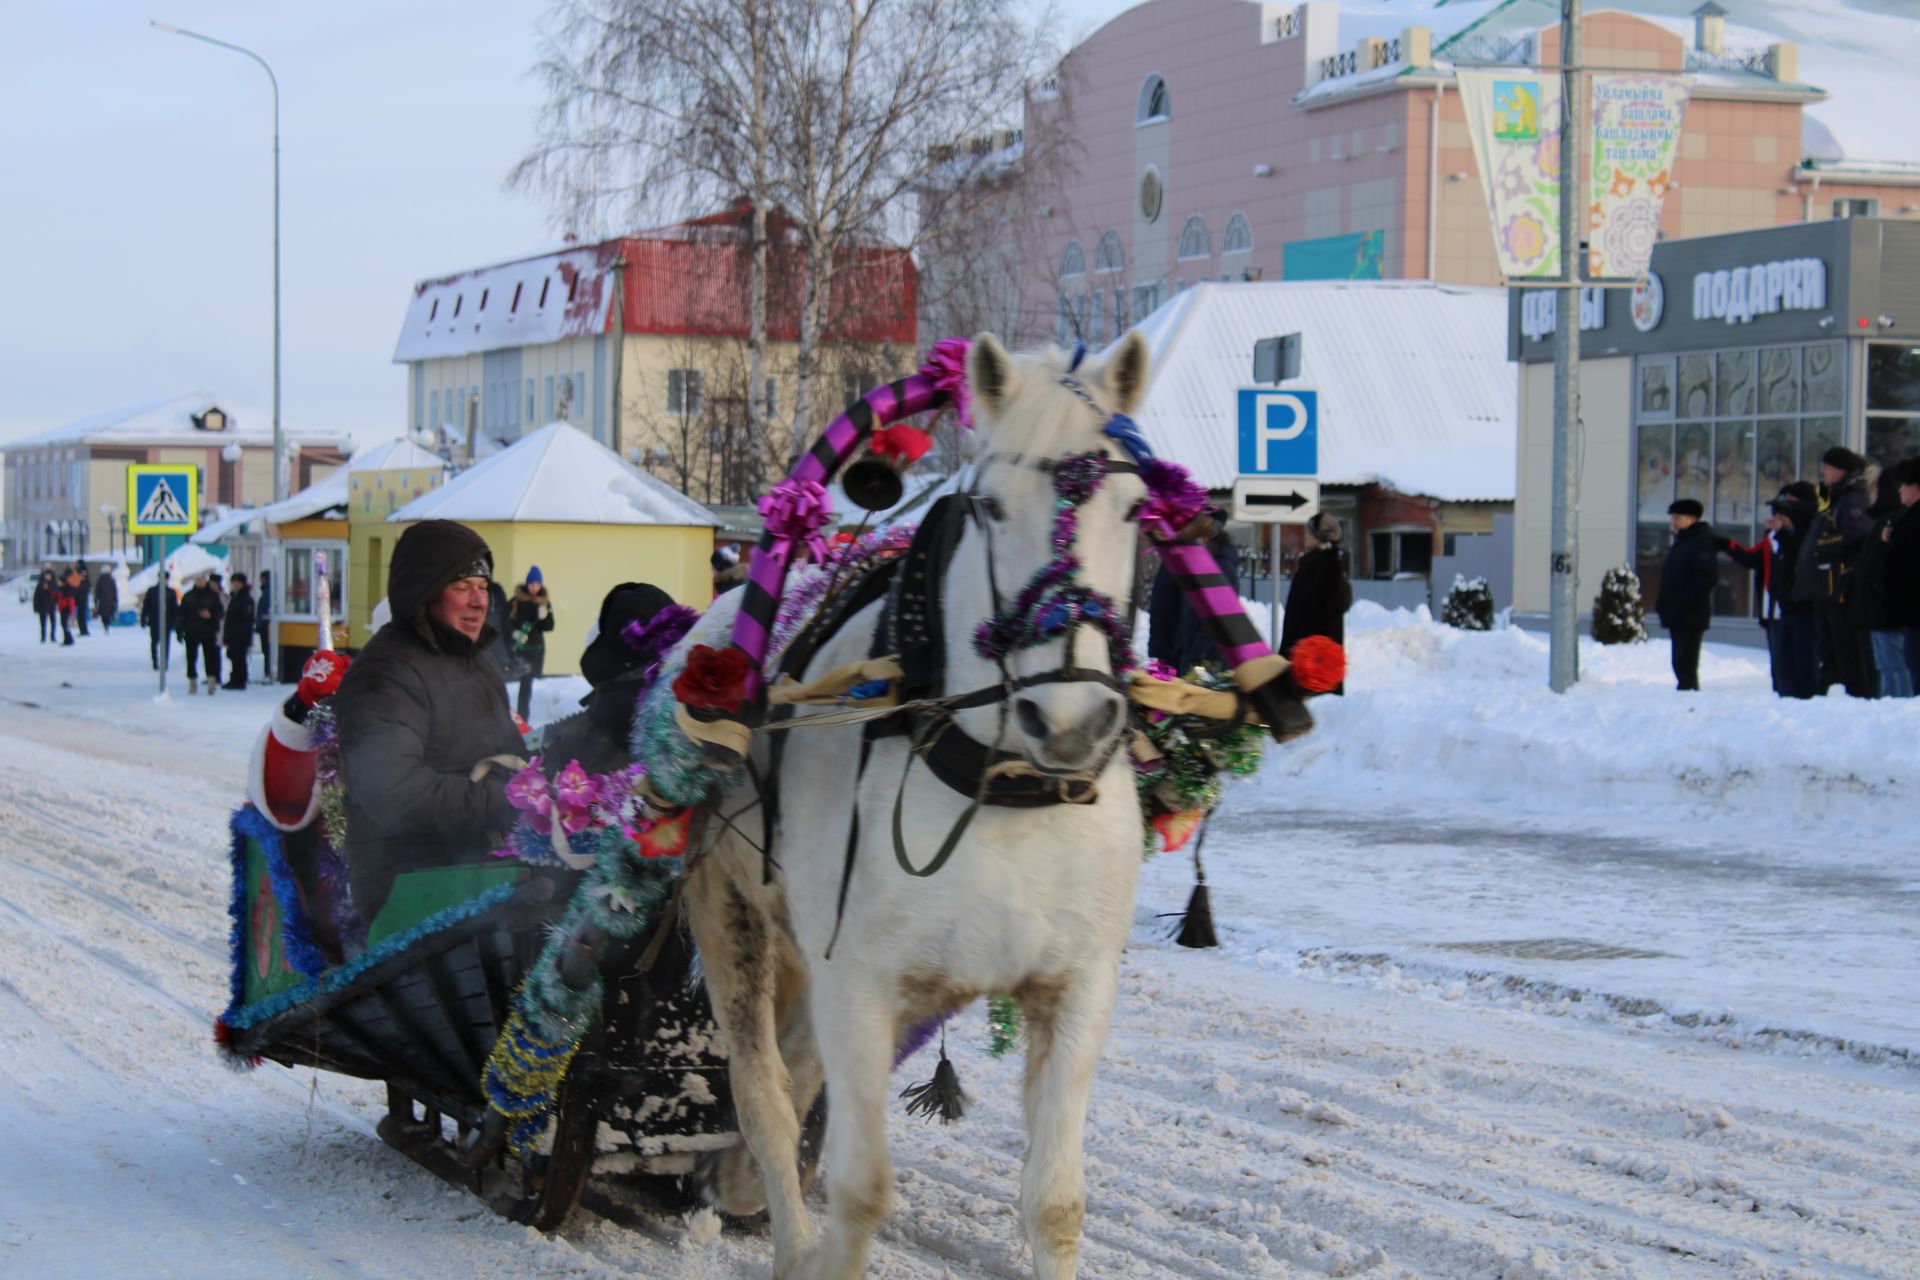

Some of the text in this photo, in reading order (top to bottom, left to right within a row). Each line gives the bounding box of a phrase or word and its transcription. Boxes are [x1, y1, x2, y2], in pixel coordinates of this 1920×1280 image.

[1521, 287, 1605, 342] ЦВЫ
[1694, 257, 1826, 325] ПОДАРКИ
[1255, 393, 1308, 472] P
